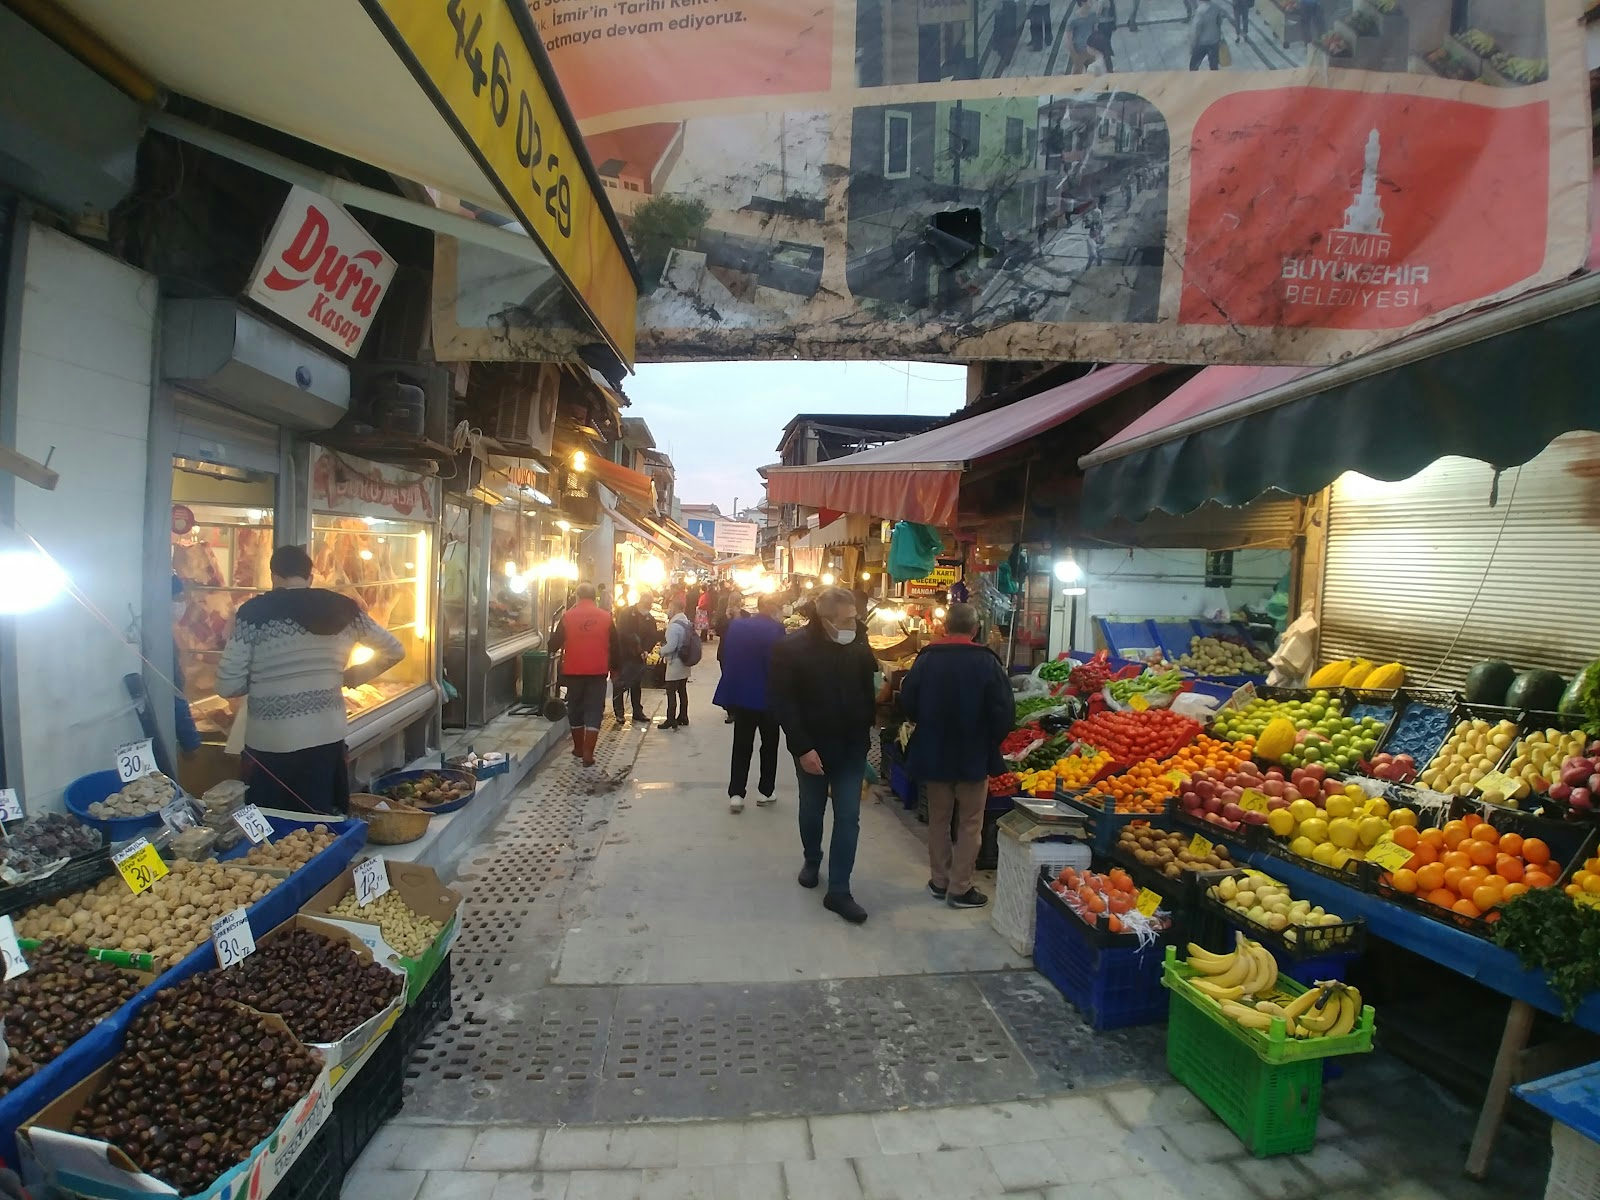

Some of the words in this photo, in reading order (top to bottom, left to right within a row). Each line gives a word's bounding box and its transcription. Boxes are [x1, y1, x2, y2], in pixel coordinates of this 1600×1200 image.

[552, 6, 608, 26] İzmir'in
[606, 22, 663, 37] devam
[668, 11, 747, 31] ediyoruz.
[546, 153, 571, 239] 29
[281, 204, 382, 318] Duru
[307, 292, 362, 348] Kasap
[120, 754, 142, 778] 30
[244, 818, 265, 838] 25
[130, 864, 151, 888] 30
[219, 937, 240, 965] 30
